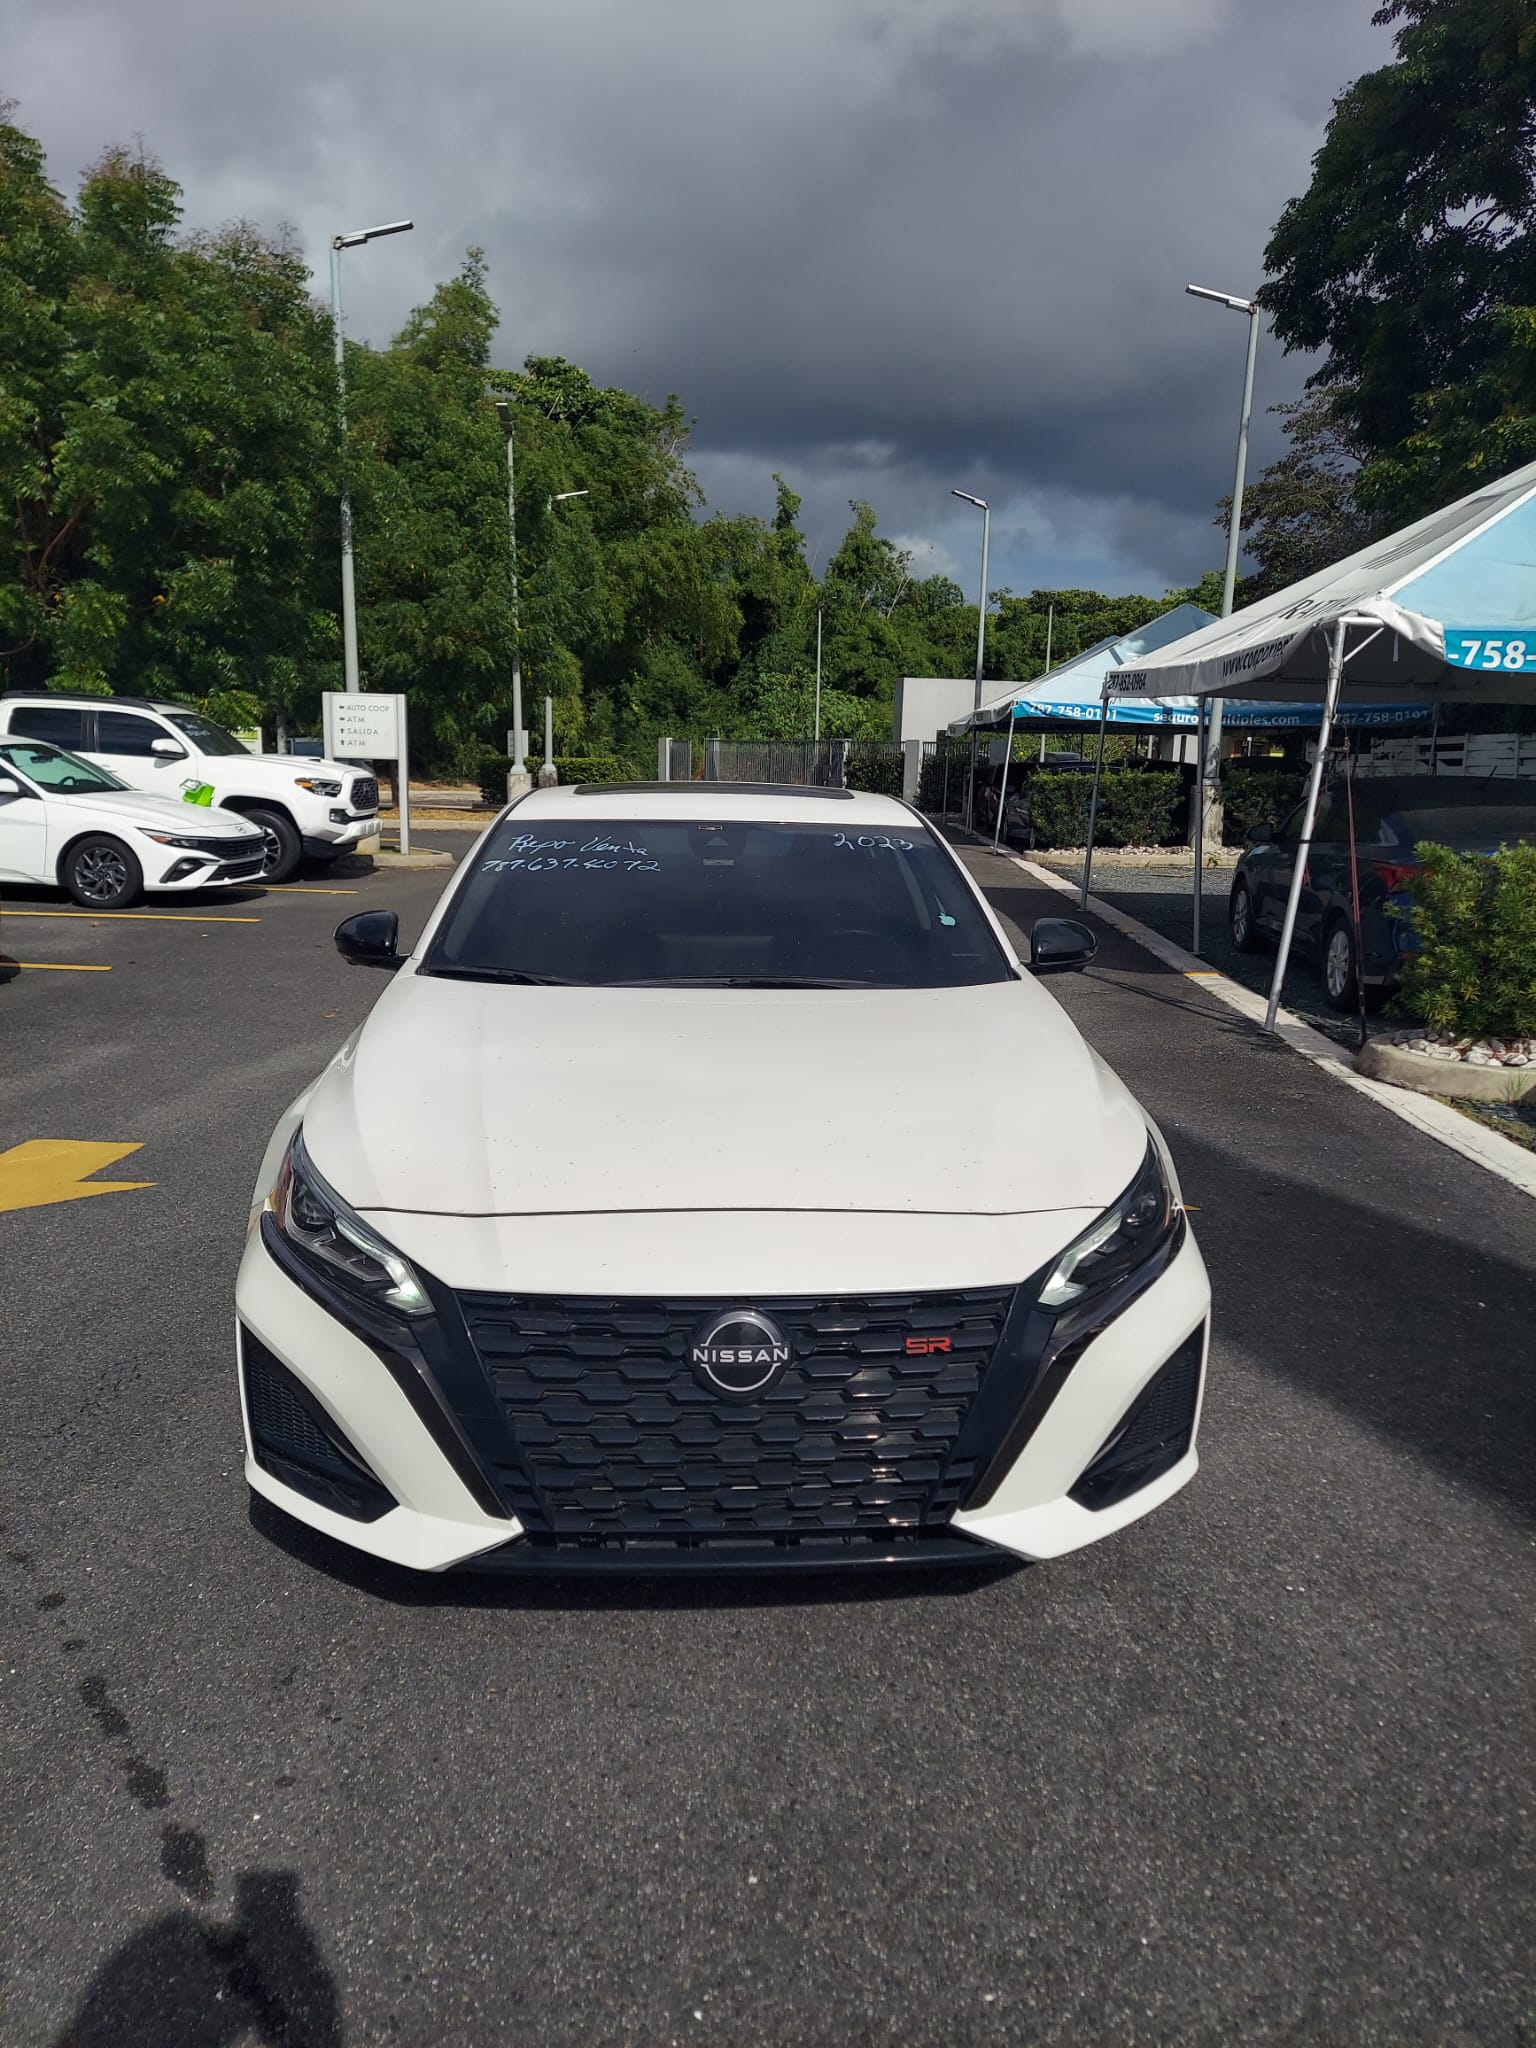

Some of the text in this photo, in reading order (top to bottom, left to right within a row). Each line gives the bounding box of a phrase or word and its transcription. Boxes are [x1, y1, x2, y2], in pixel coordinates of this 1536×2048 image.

[347, 727, 378, 735] SALIDA
[508, 833, 649, 856] Repo Venta
[833, 832, 914, 850] 2023
[693, 1347, 788, 1363] NISSAN
[905, 1342, 952, 1355] SR
